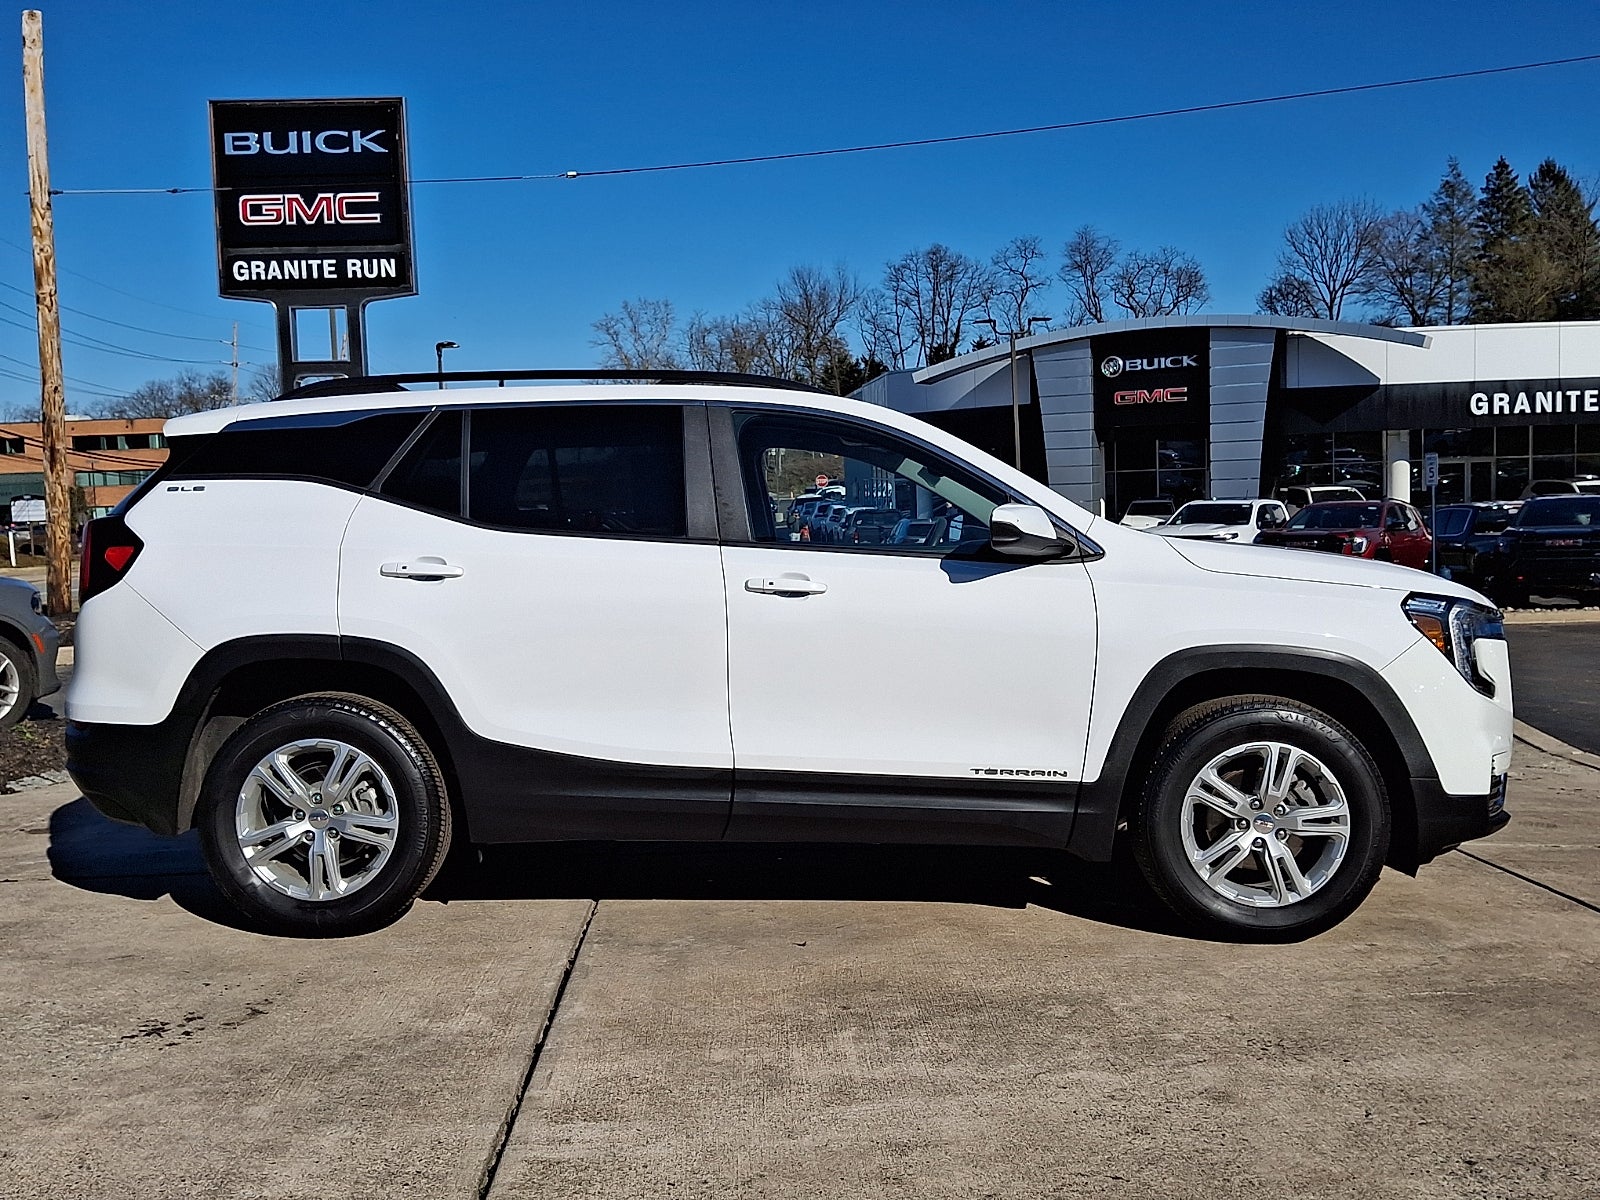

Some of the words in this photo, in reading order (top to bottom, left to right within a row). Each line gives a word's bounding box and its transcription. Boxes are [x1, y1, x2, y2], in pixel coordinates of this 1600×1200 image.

[224, 130, 388, 155] BUICK
[239, 192, 382, 226] GMC
[233, 260, 337, 281] GRANITE
[347, 258, 396, 279] RUN
[1126, 355, 1198, 371] BUICK
[1114, 387, 1188, 405] GMC
[1470, 390, 1599, 415] GRANITE
[970, 767, 1067, 777] TERRAIN
